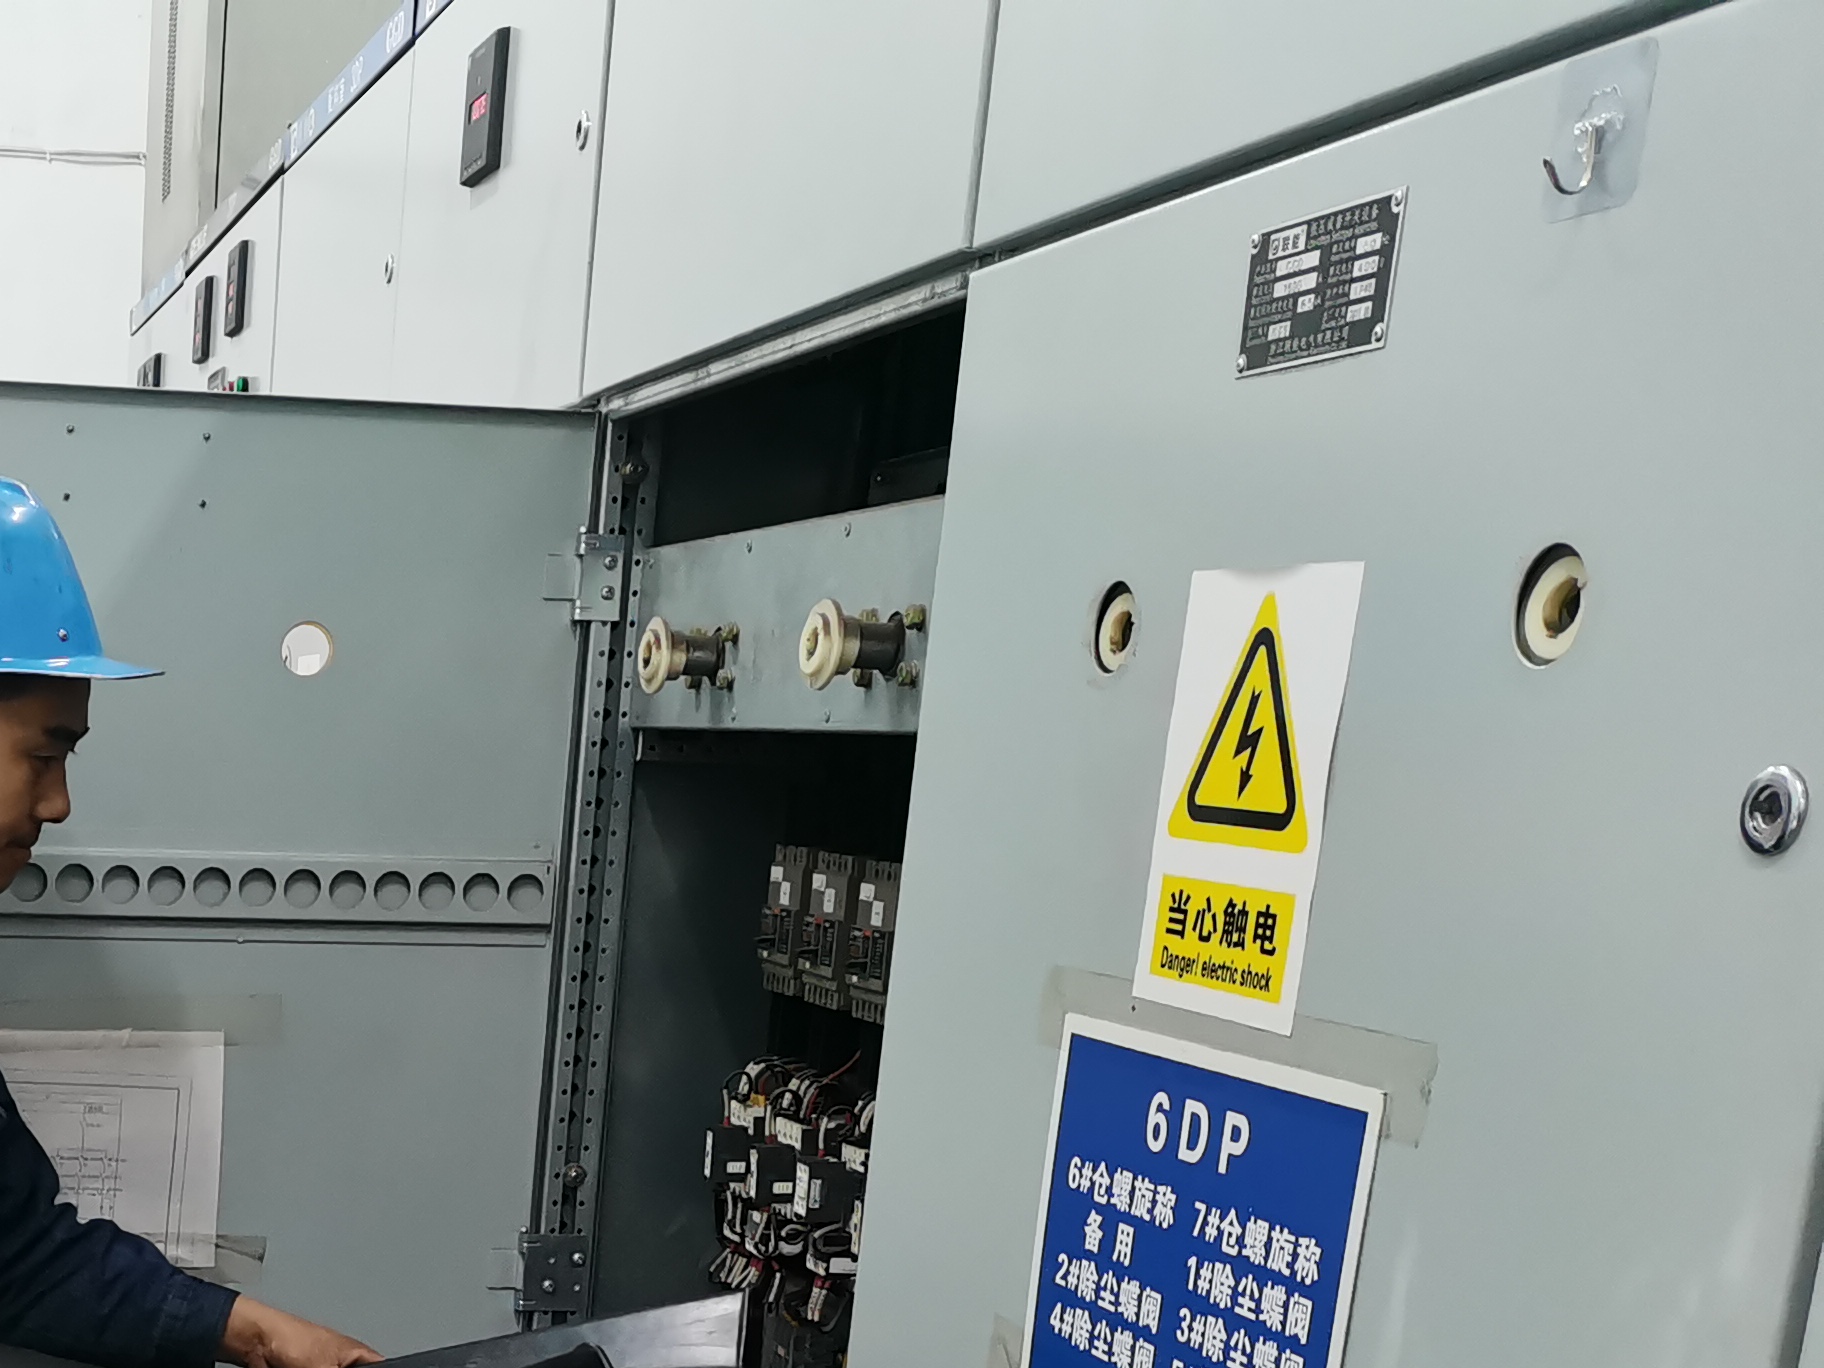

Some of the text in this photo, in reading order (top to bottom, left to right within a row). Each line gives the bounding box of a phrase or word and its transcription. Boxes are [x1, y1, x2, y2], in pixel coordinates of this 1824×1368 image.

[1165, 888, 1277, 957] 当心触电
[1160, 945, 1272, 993] Danger! electric shock
[1146, 1091, 1250, 1174] 6DP
[1068, 1156, 1176, 1229] 6#仓螺旋称
[1192, 1201, 1322, 1285] 7#仓螺旋称
[1055, 1253, 1162, 1335] 2#除尘蝶阀
[1187, 1256, 1313, 1344] 1#除尘蝶阀
